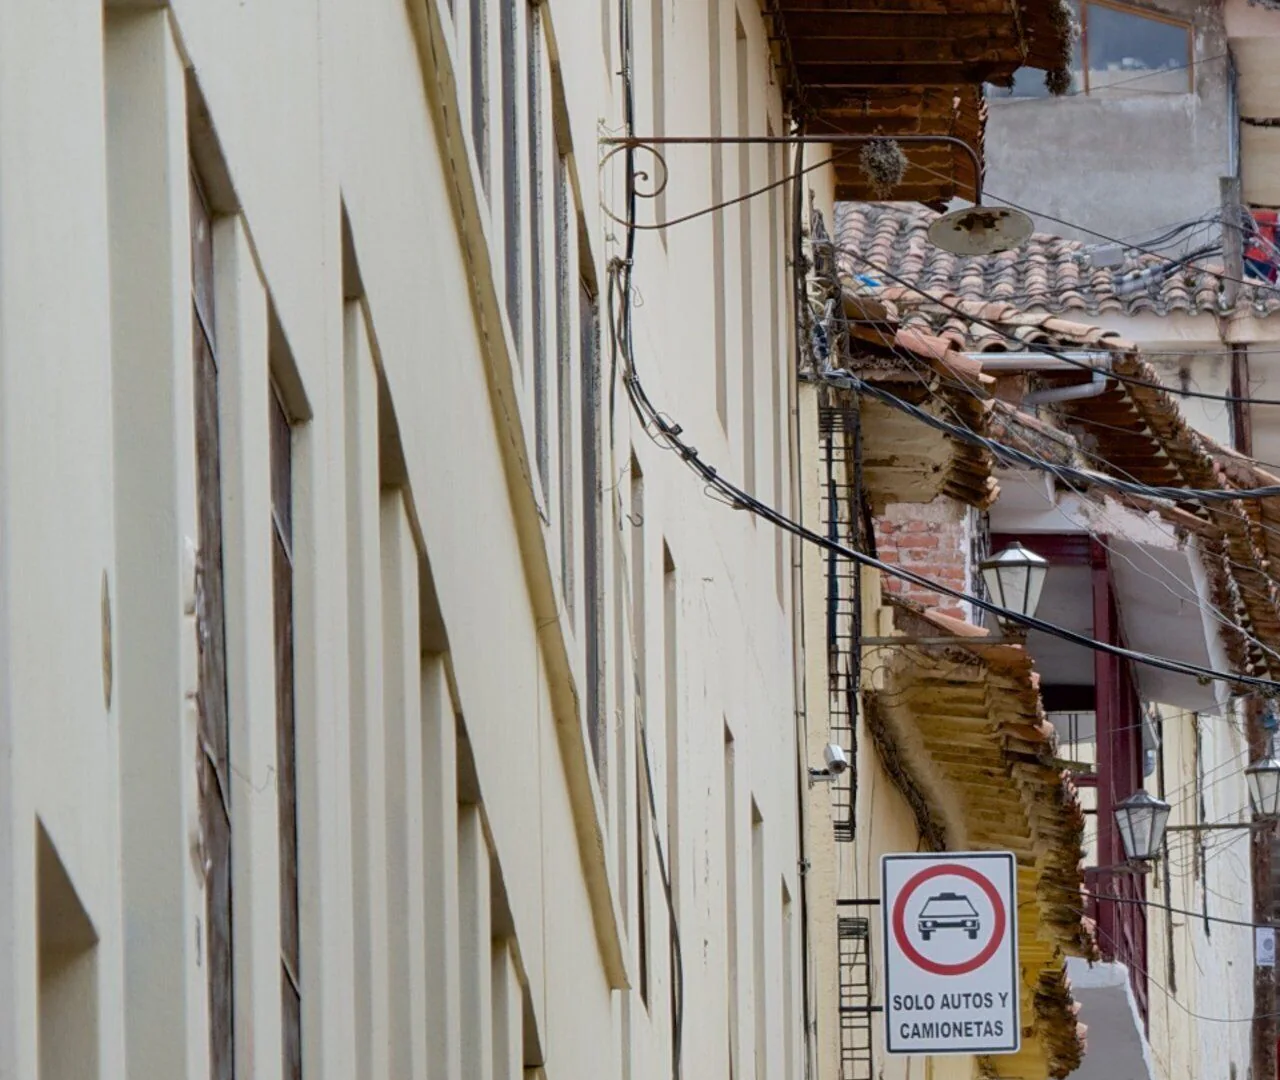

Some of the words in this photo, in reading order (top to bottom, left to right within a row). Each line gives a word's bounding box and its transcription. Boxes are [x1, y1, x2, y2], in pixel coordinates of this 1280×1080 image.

[893, 994, 935, 1011] SOLO
[940, 992, 993, 1010] AUTOS
[998, 992, 1009, 1008] Y
[900, 1020, 1004, 1039] CAMIONETAS
